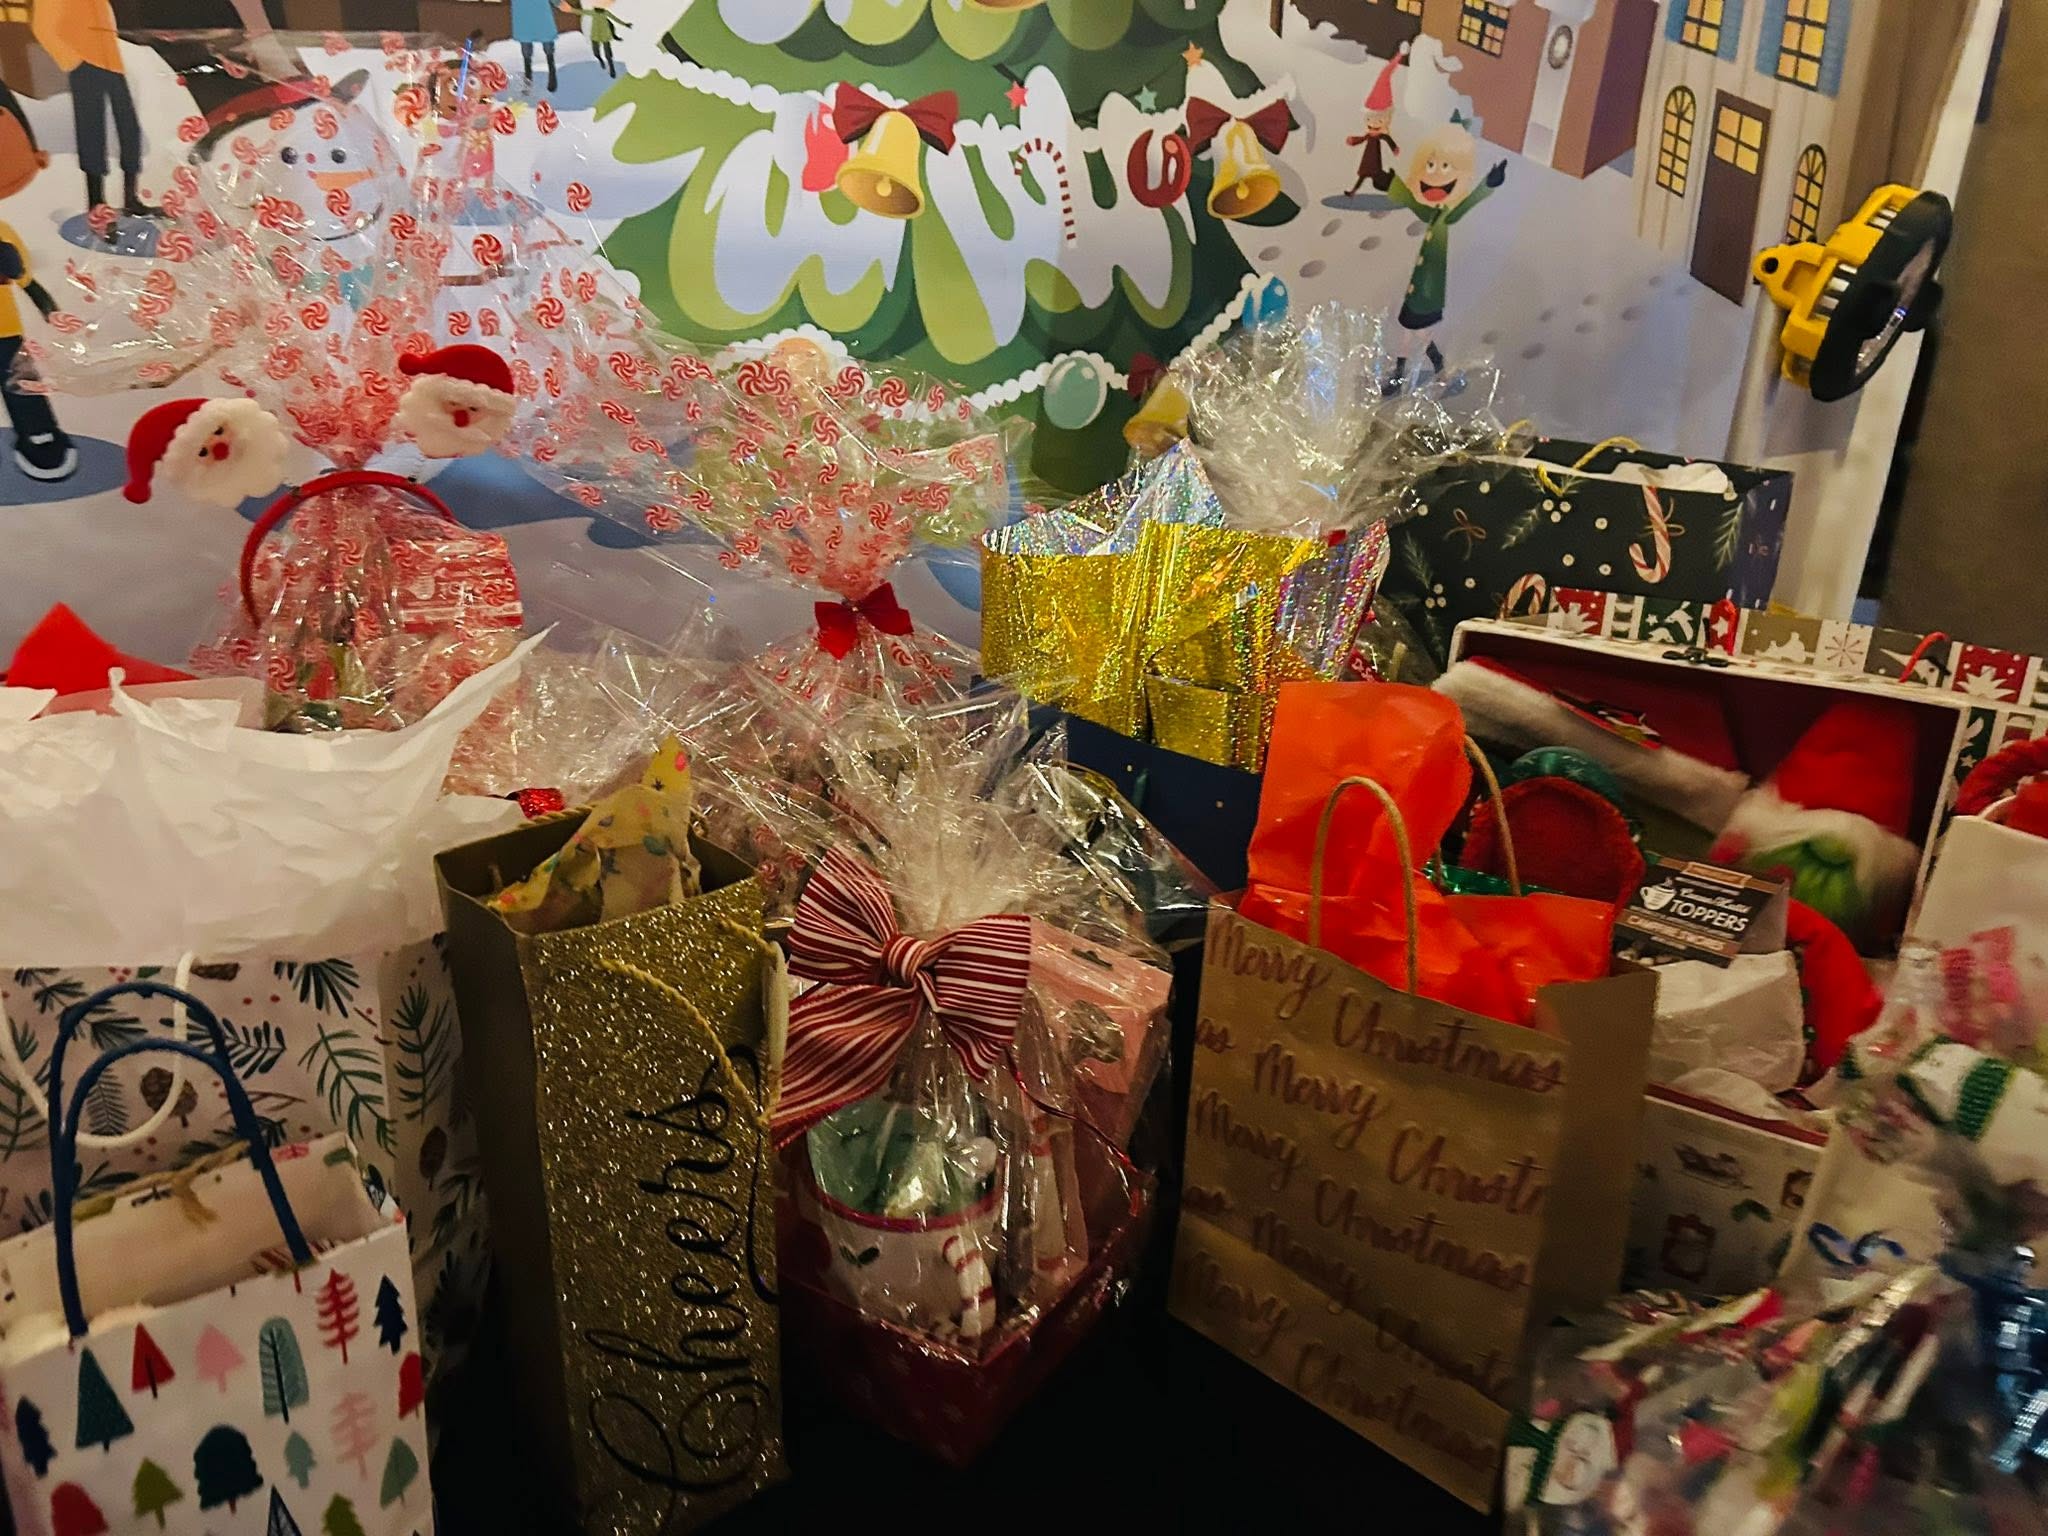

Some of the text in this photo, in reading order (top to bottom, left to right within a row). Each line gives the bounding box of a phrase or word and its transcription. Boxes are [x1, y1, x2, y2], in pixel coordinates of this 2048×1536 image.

[1207, 914, 1564, 1093] Merry Christmas
[1669, 899, 1748, 932] TOPPERS
[1195, 1091, 1531, 1291] Merry Christmas
[1254, 1043, 1548, 1215] Merry Christ
[585, 1043, 781, 1534] Cheers
